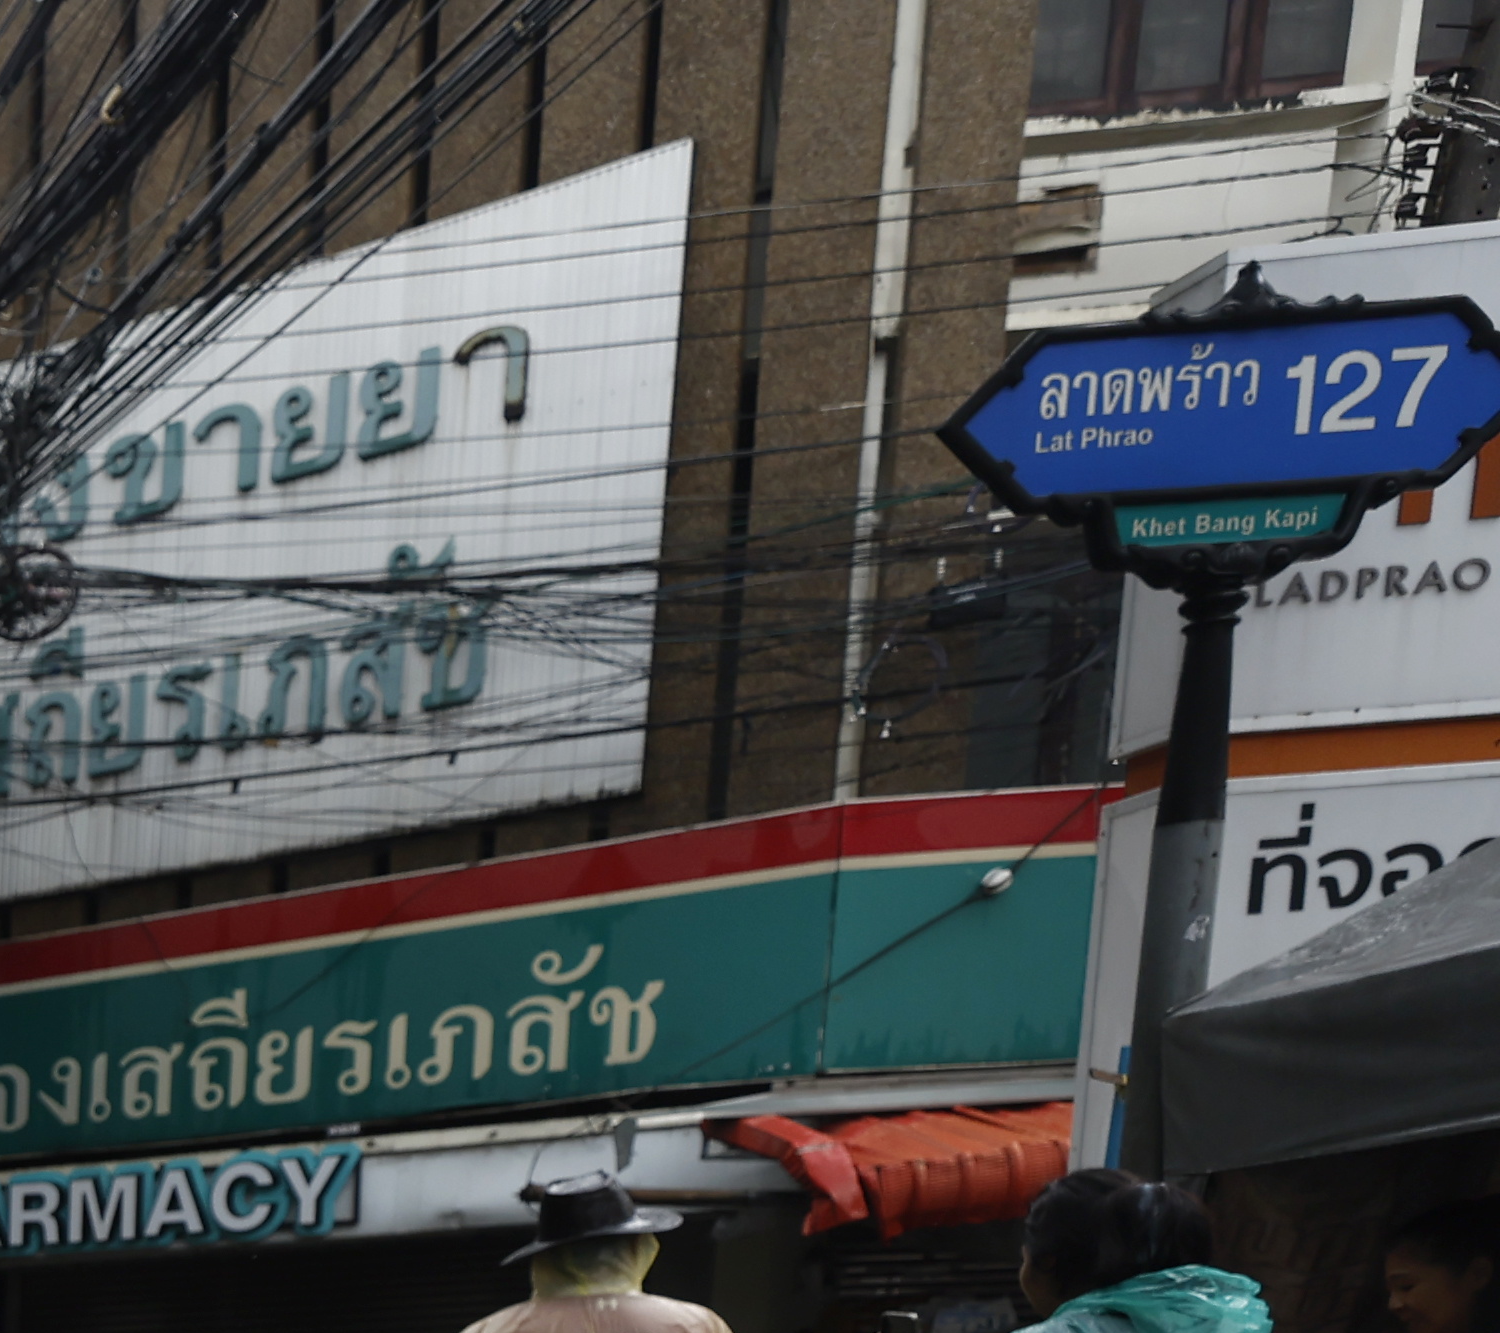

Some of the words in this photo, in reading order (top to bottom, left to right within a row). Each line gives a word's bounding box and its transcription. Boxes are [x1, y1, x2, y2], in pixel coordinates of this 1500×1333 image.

[1038, 343, 1261, 420] ลาดพร้าว
[1286, 344, 1449, 435] 127
[1034, 429, 1075, 454] Lat
[1080, 426, 1154, 450] Phrao
[1131, 517, 1189, 539] Khet
[1194, 511, 1256, 538] Bang
[1264, 506, 1319, 531] Kapi
[1254, 557, 1492, 608] LADPRAO
[1247, 802, 1500, 915] ที่จอ
